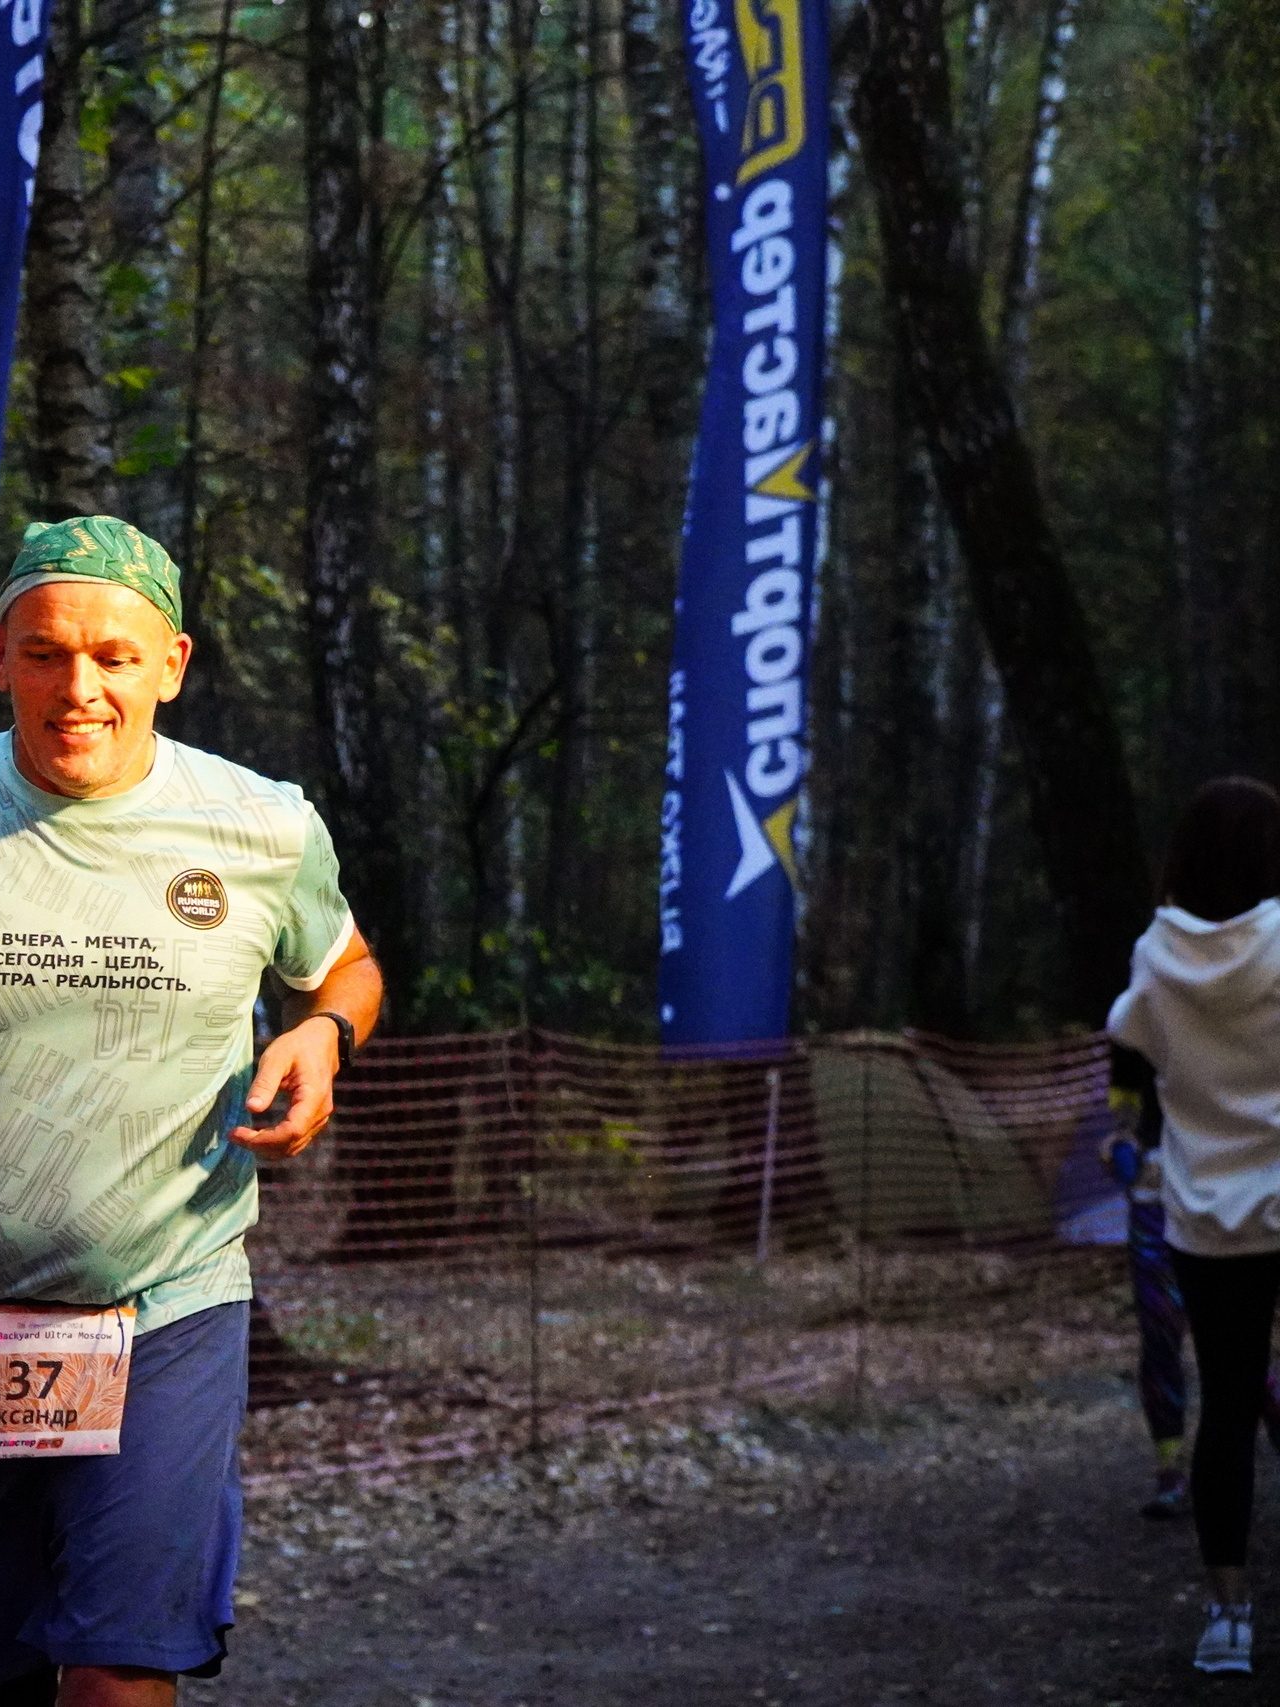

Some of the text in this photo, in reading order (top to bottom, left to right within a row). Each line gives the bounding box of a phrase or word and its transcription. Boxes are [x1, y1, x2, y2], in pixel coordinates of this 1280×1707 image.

[177, 897, 220, 909] RUNNERS
[182, 906, 217, 917] WORLD
[1, 933, 65, 948] ВЧЕРА
[85, 935, 157, 952] МЕЧТА,
[105, 956, 165, 973] ЦЕЛЬ,
[56, 974, 192, 992] РЕАЛЬНОСТЬ.
[44, 1331, 73, 1340] Ultra
[78, 1332, 112, 1340] Moscow
